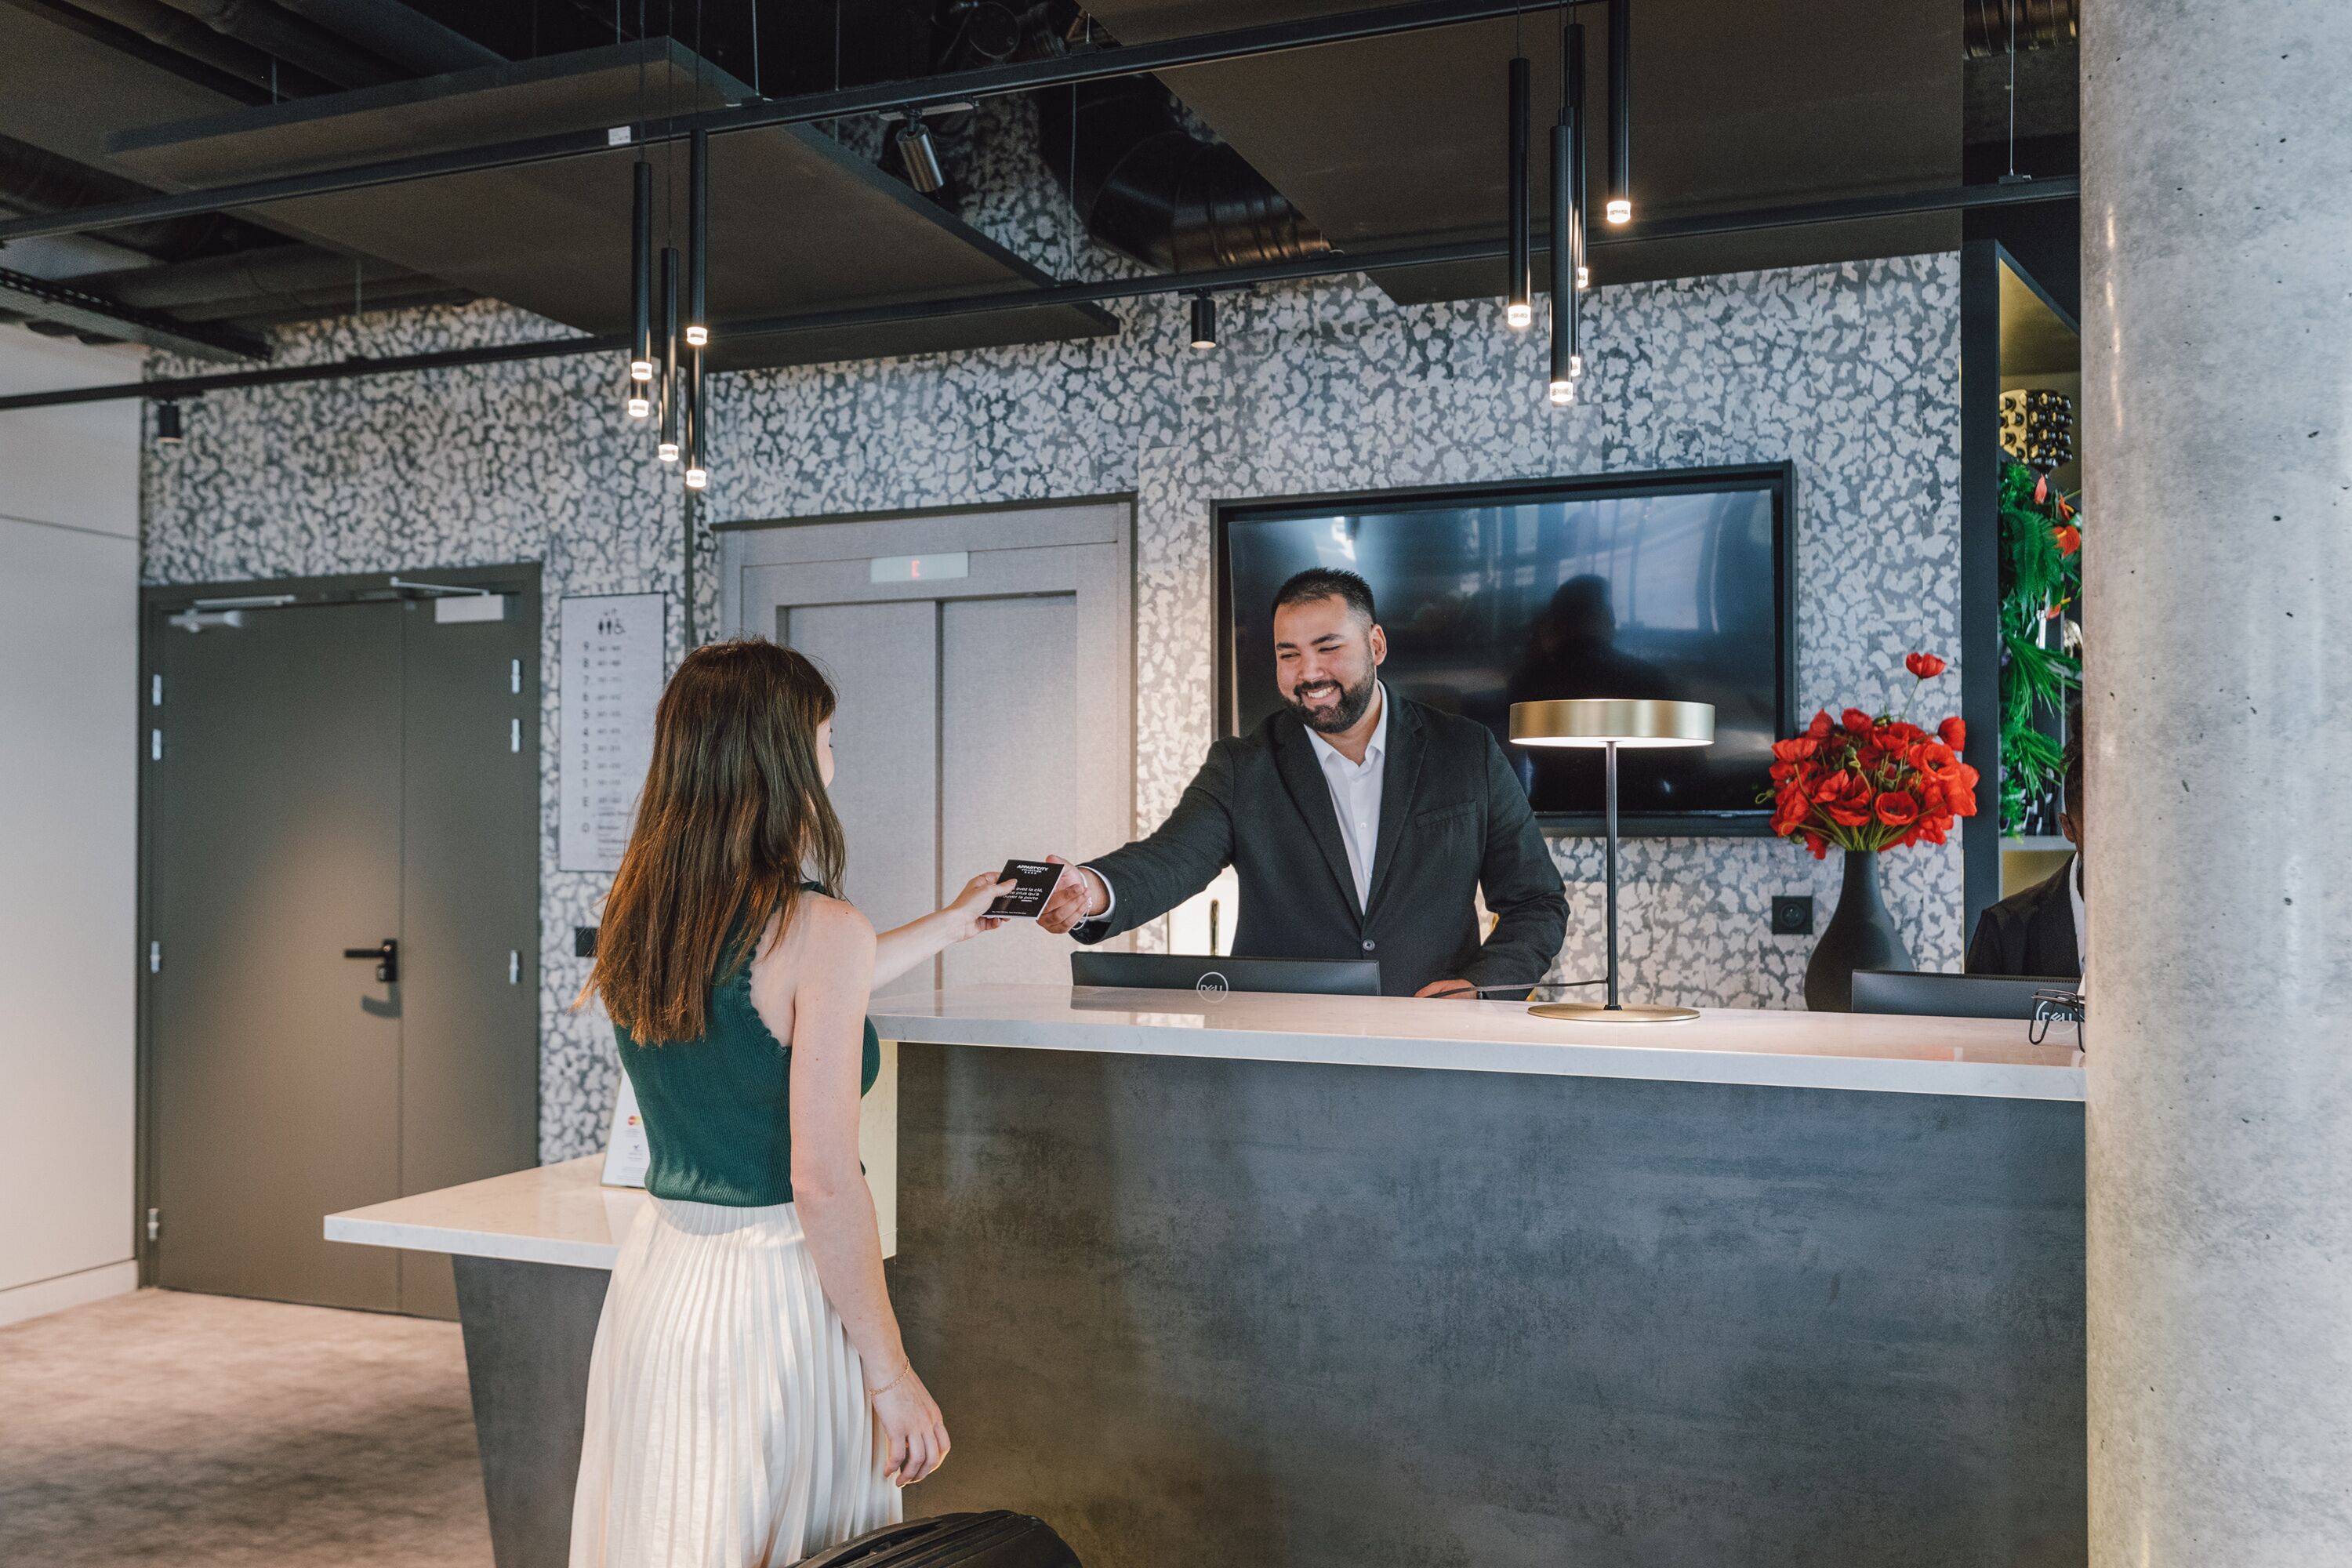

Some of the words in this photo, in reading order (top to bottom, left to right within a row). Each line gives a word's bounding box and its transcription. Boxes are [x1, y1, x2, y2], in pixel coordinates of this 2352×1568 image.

[583, 709, 589, 720] 5
[583, 742, 589, 754] 3
[583, 759, 589, 771] 2
[583, 797, 589, 808] E
